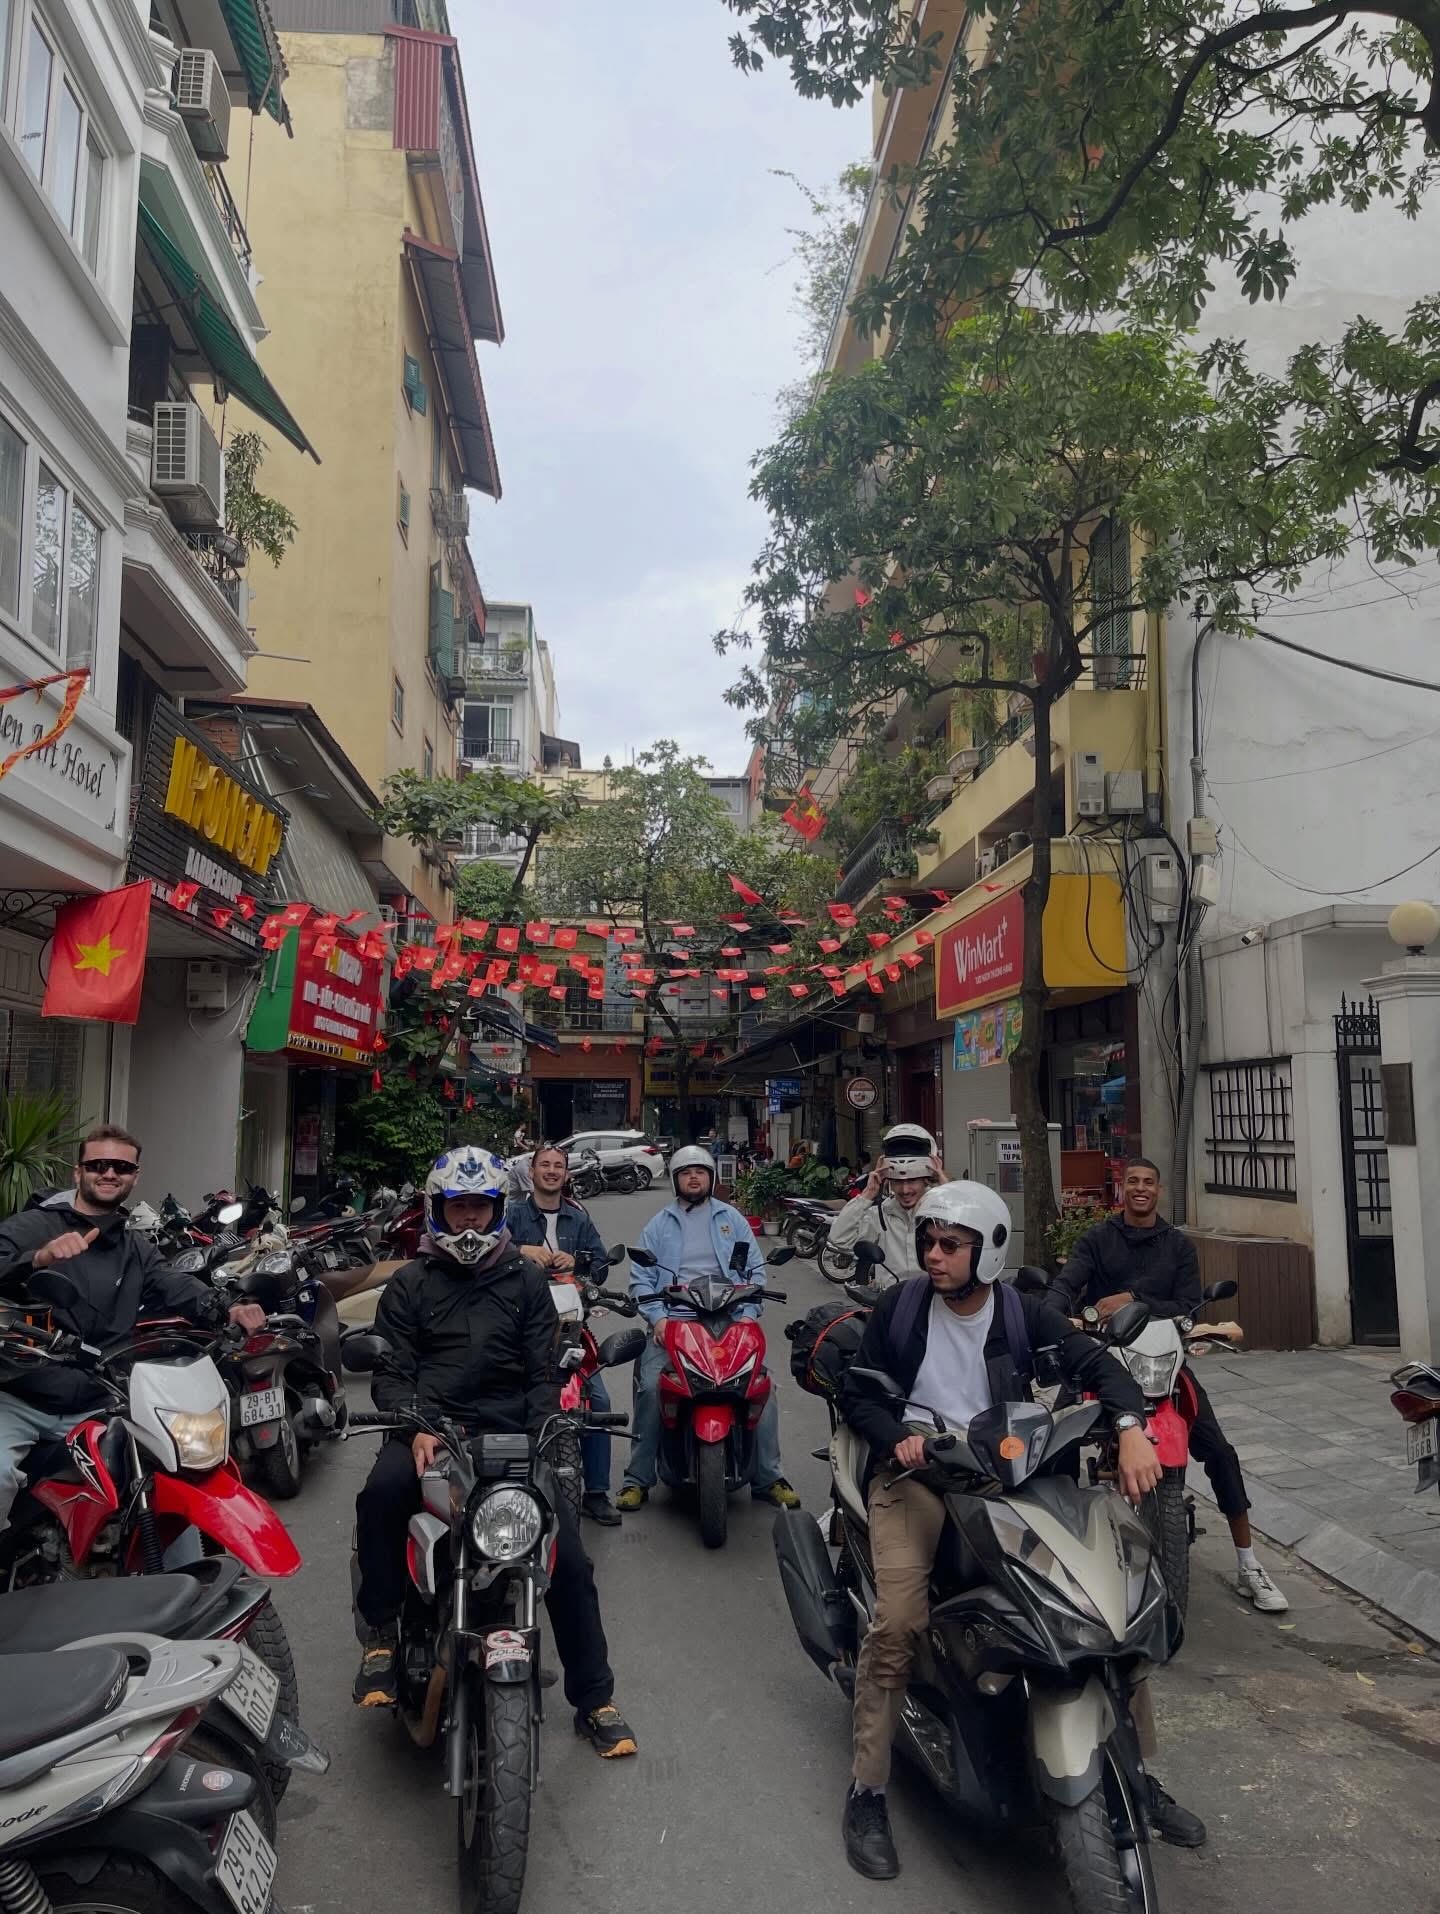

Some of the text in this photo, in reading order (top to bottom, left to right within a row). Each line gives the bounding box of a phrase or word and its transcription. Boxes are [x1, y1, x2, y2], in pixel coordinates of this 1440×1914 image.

[61, 742, 106, 800] Hotel
[244, 1402, 281, 1424] 684.31
[180, 1763, 197, 1792] HONDA
[0, 1804, 49, 1829] ode
